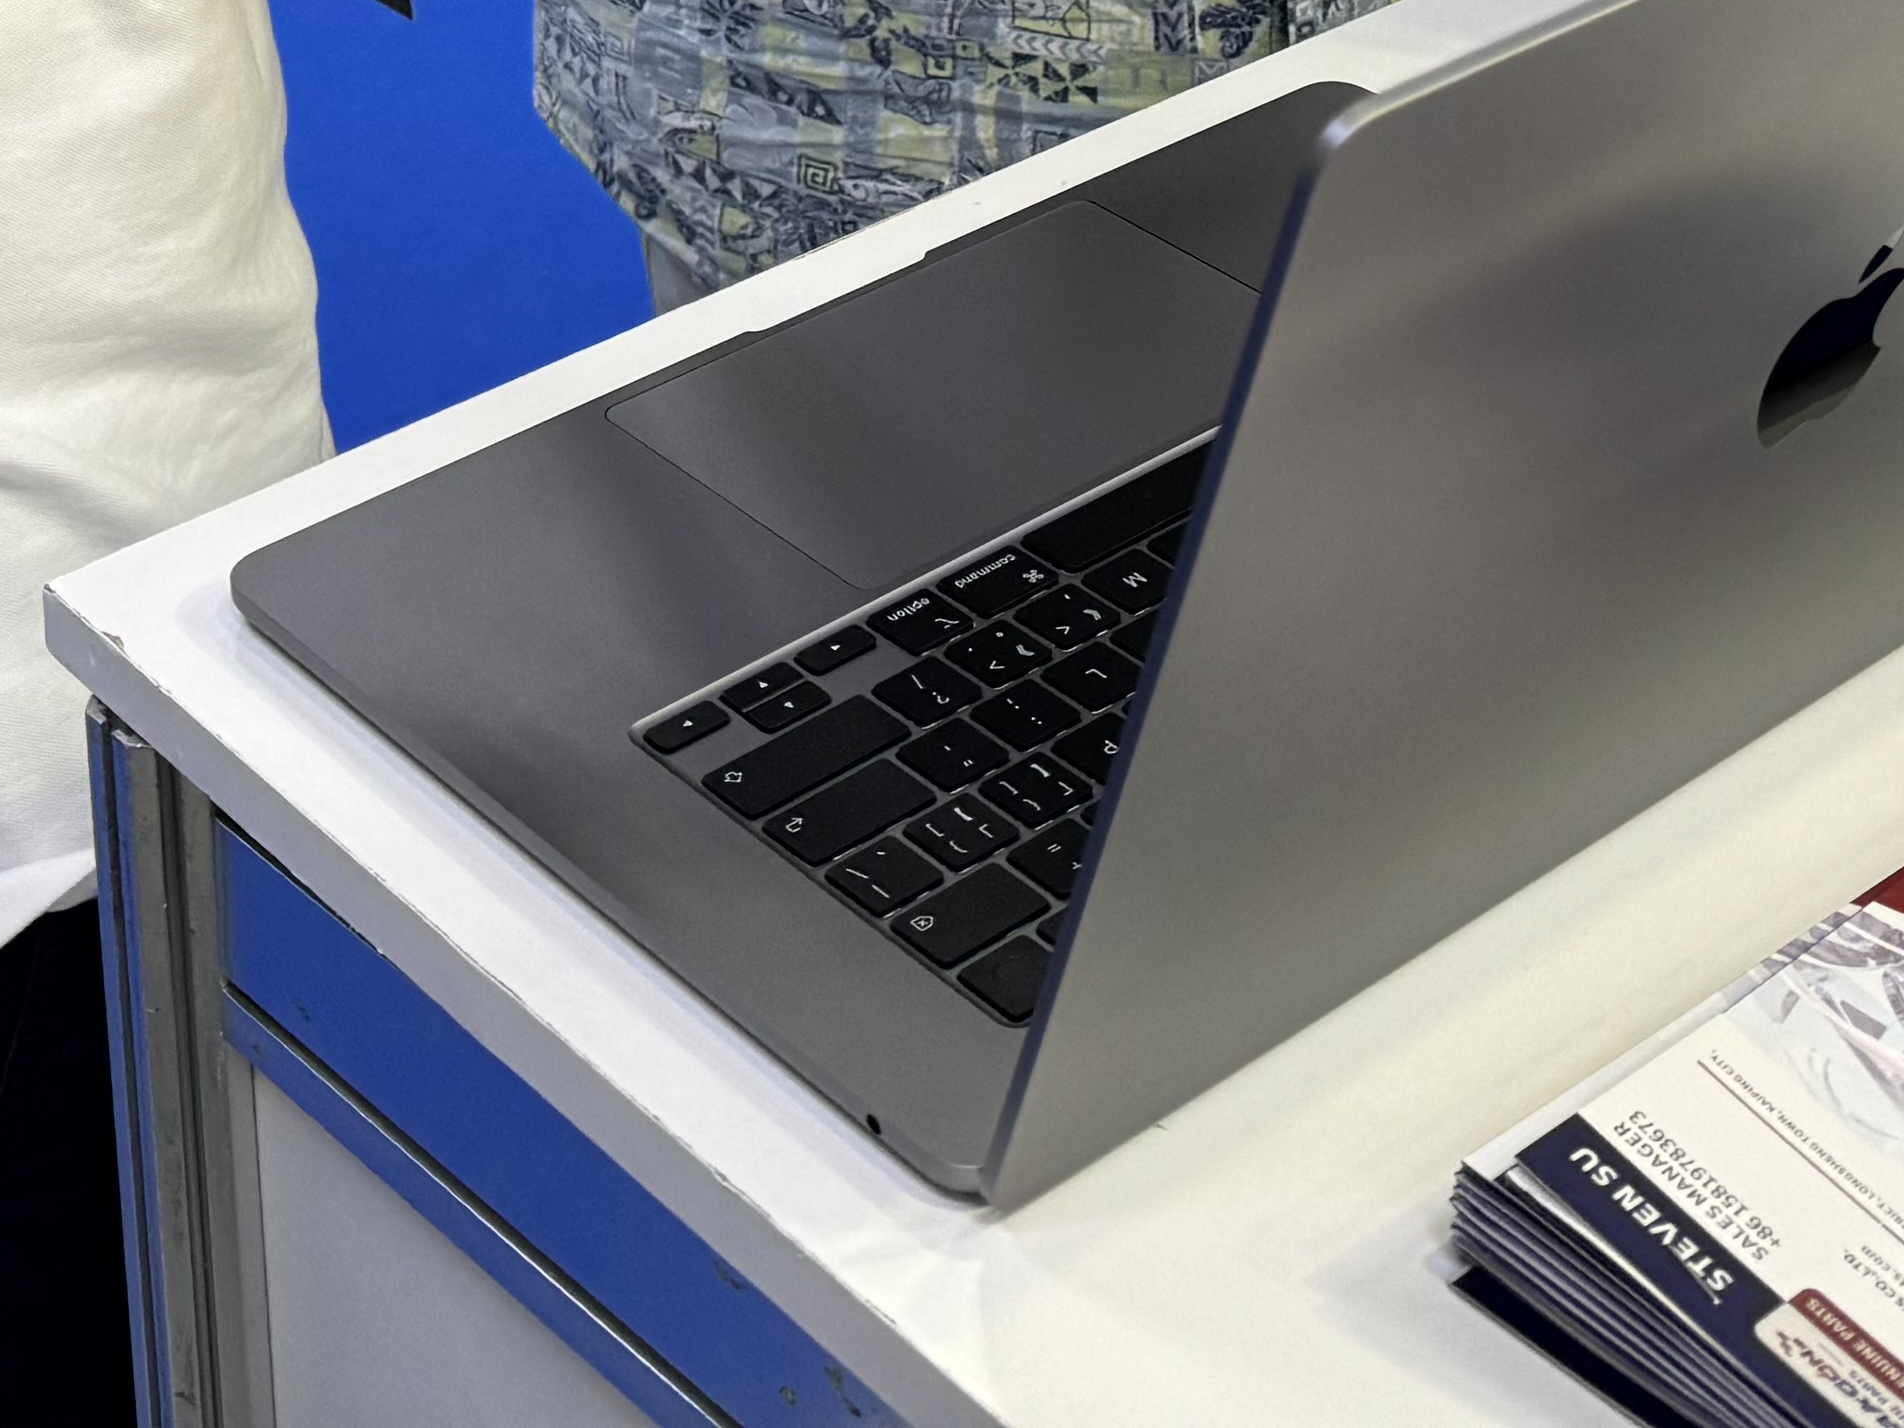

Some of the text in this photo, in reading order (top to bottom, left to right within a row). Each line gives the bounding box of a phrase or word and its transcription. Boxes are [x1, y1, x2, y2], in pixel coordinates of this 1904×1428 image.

[886, 596, 931, 622] option
[954, 553, 1016, 589] command
[1568, 1146, 1735, 1292] STEVEN SU
[1613, 1119, 1769, 1262] SALES MANAGER
[1627, 1109, 1781, 1249] +86 15819783673
[1805, 1297, 1855, 1345] PARTS
